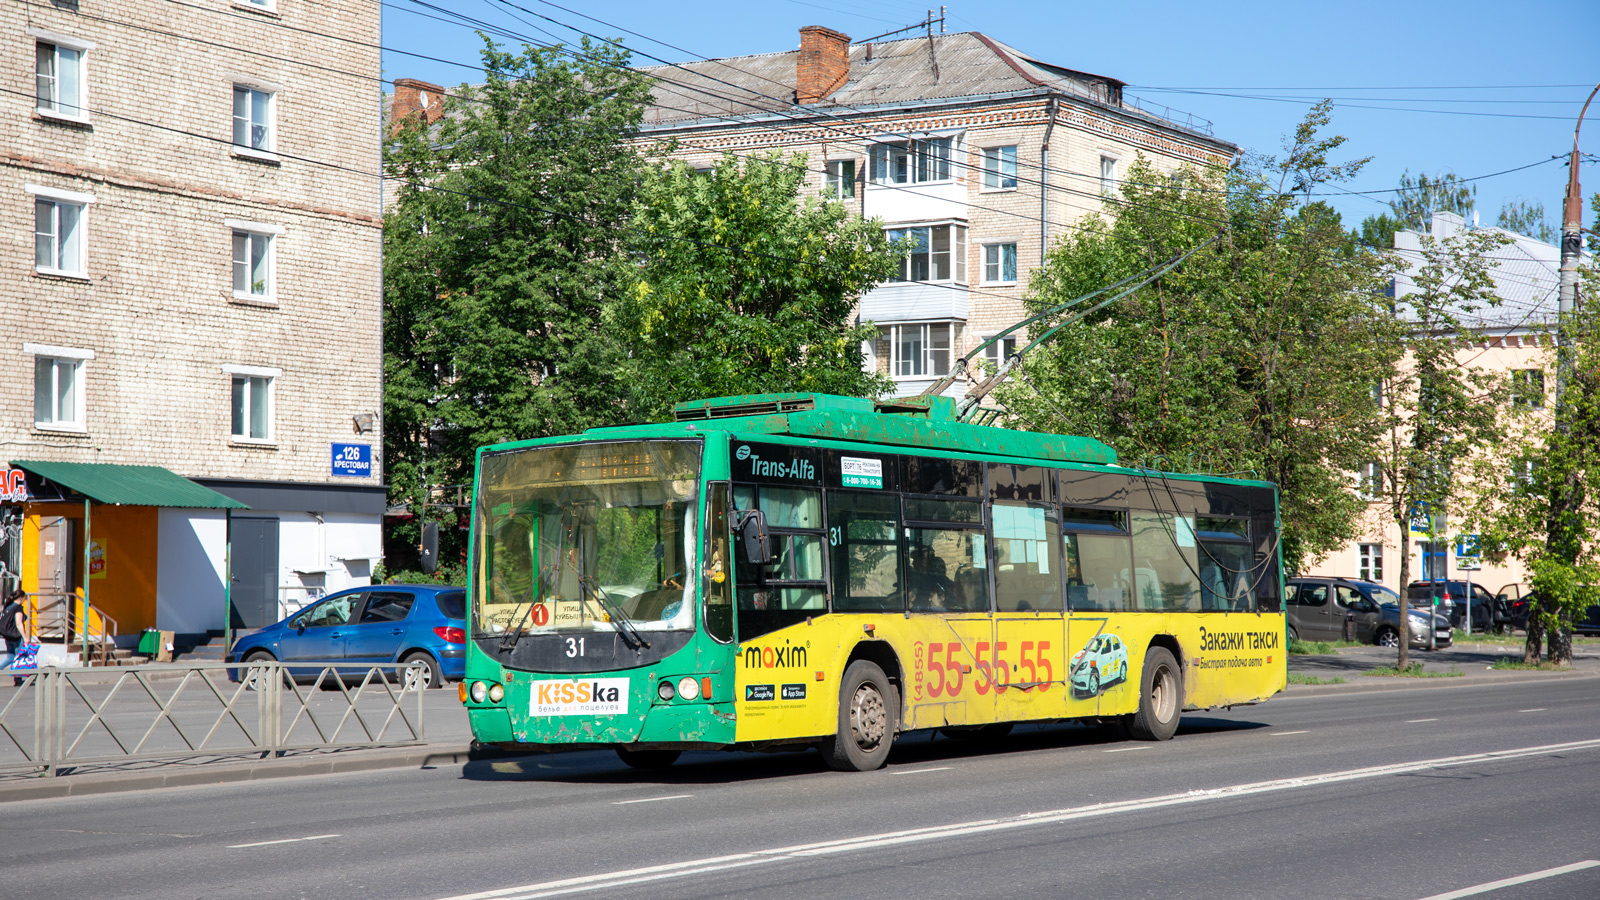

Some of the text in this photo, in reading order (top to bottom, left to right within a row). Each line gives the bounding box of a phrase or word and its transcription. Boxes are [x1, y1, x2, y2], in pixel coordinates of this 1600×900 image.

[343, 446, 360, 460] 126
[334, 460, 369, 469] КРЕСТОВАЯ
[750, 454, 815, 480] Trans-Alfa
[830, 525, 842, 546] 31
[565, 637, 585, 658] 31
[1199, 626, 1278, 651] Закажи такси
[914, 641, 924, 701] (4855)
[1200, 655, 1263, 671] Быстрая подача авто
[753, 691, 767, 700] Google
[538, 705, 561, 713] белье
[580, 704, 619, 712] поцелуев
